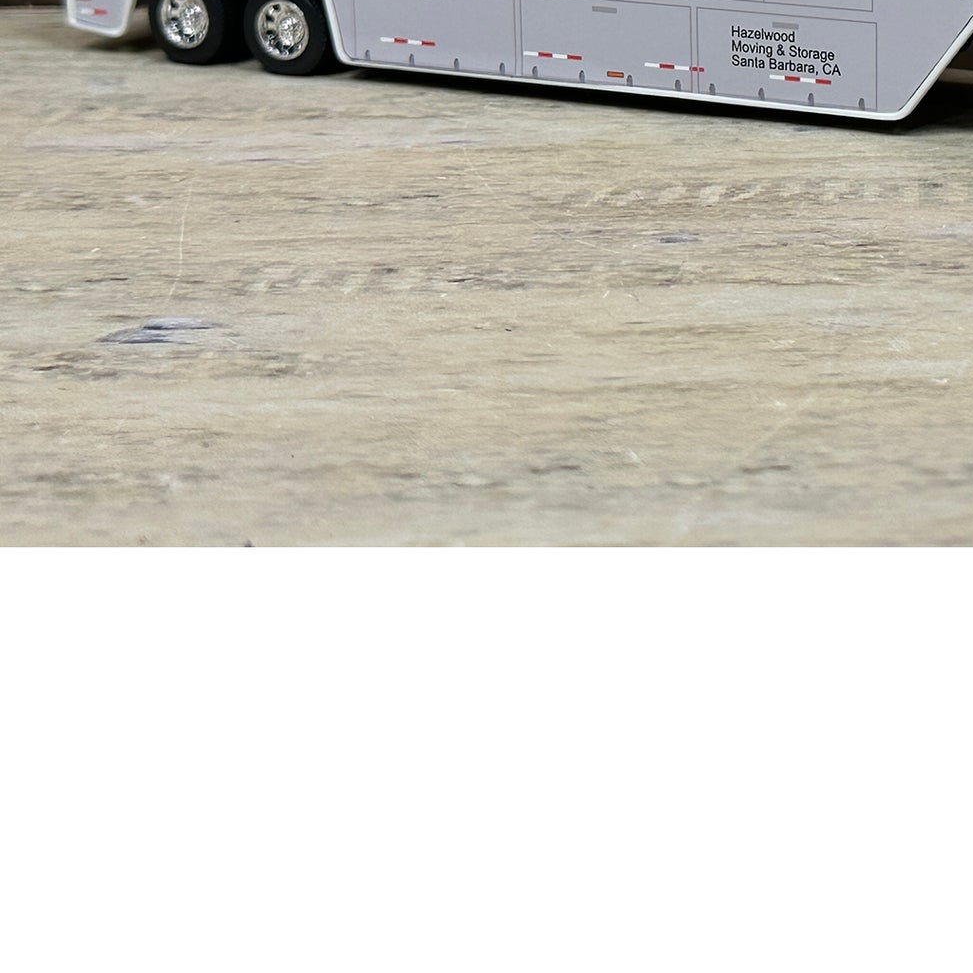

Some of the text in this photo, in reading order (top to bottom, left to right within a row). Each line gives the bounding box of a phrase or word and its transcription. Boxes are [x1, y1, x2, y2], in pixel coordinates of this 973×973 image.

[731, 25, 796, 42] Hazelwood
[731, 40, 835, 63] Moving & Storage
[731, 54, 842, 76] Santa Barbara, CA
